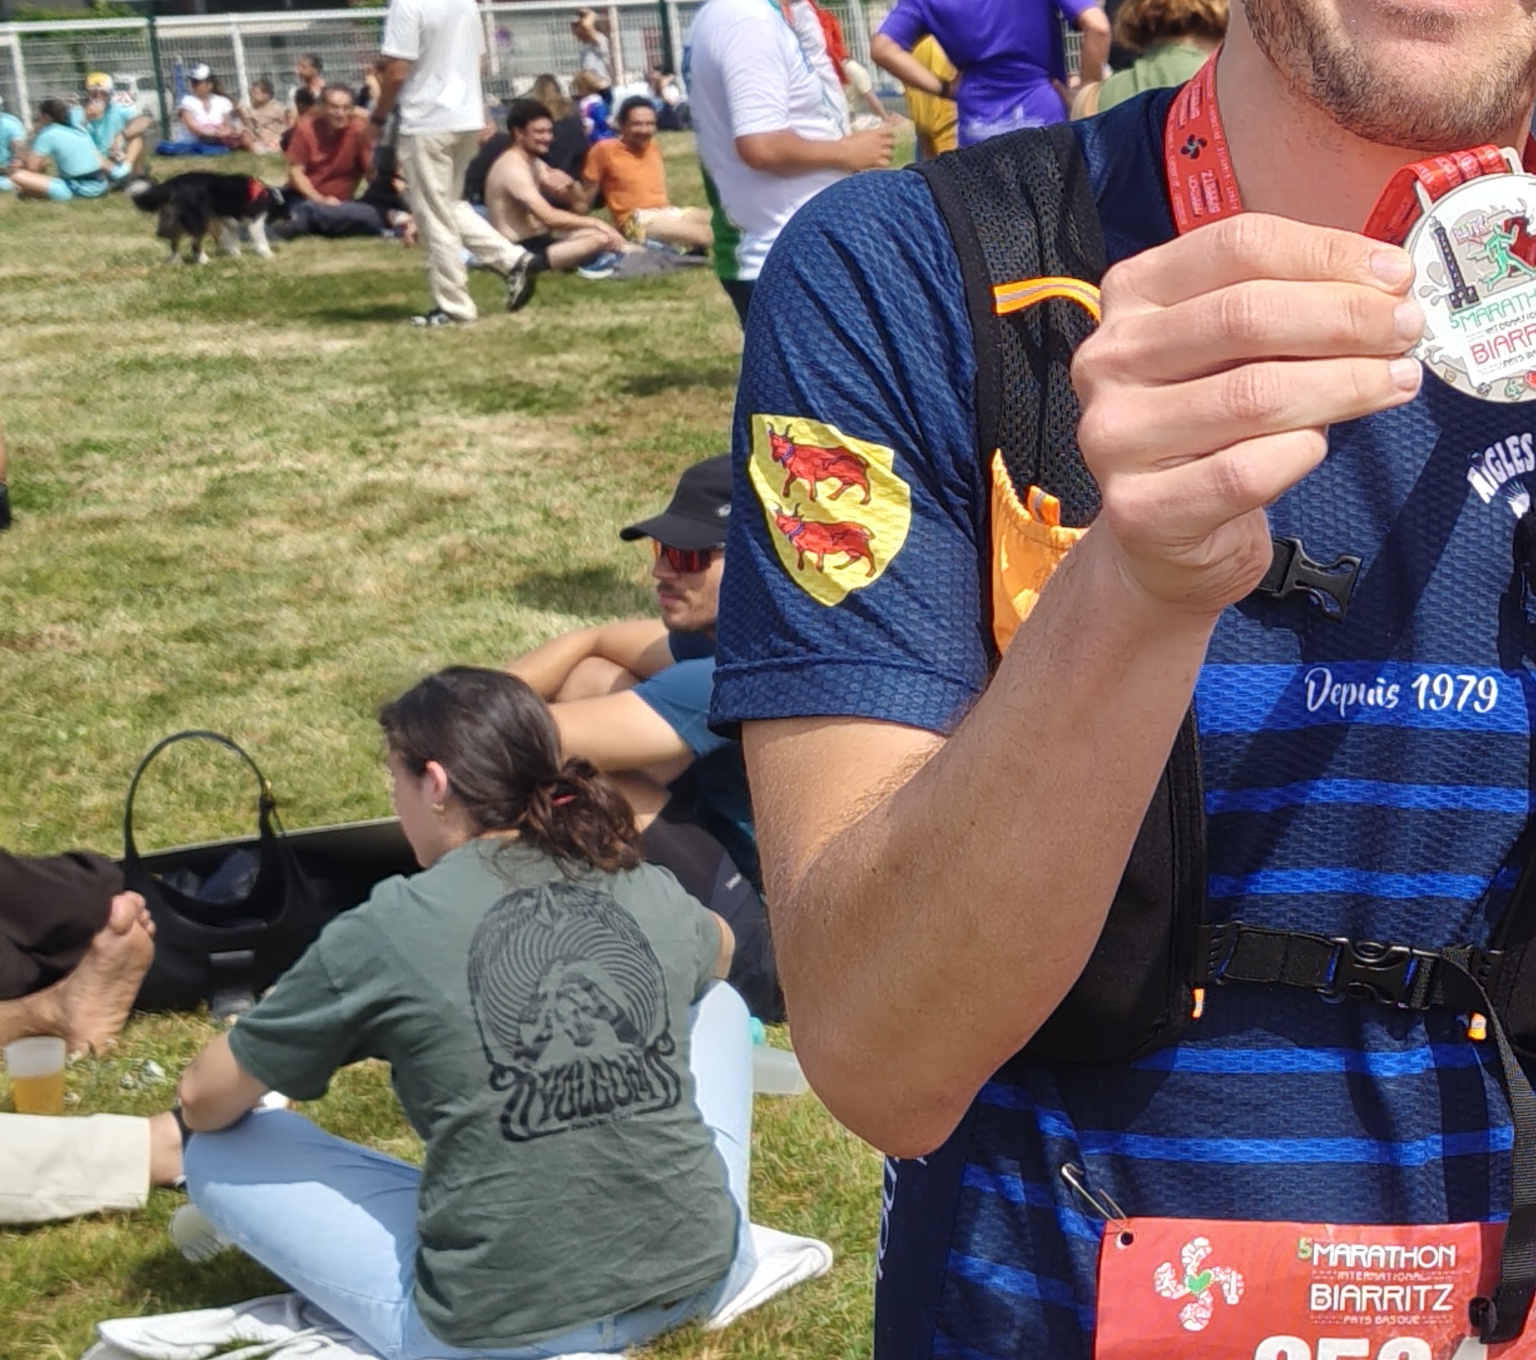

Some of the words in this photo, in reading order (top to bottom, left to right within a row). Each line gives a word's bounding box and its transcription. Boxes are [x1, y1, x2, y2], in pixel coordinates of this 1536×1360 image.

[1467, 433, 1534, 504] AIGLES
[1305, 667, 1400, 718] Depuis
[1411, 673, 1498, 713] 1979
[1313, 1243, 1455, 1269] MARATHON
[1310, 1284, 1455, 1312] BIARRITZ
[1343, 1315, 1372, 1325] PAYS
[1375, 1315, 1420, 1325] BASQUE
